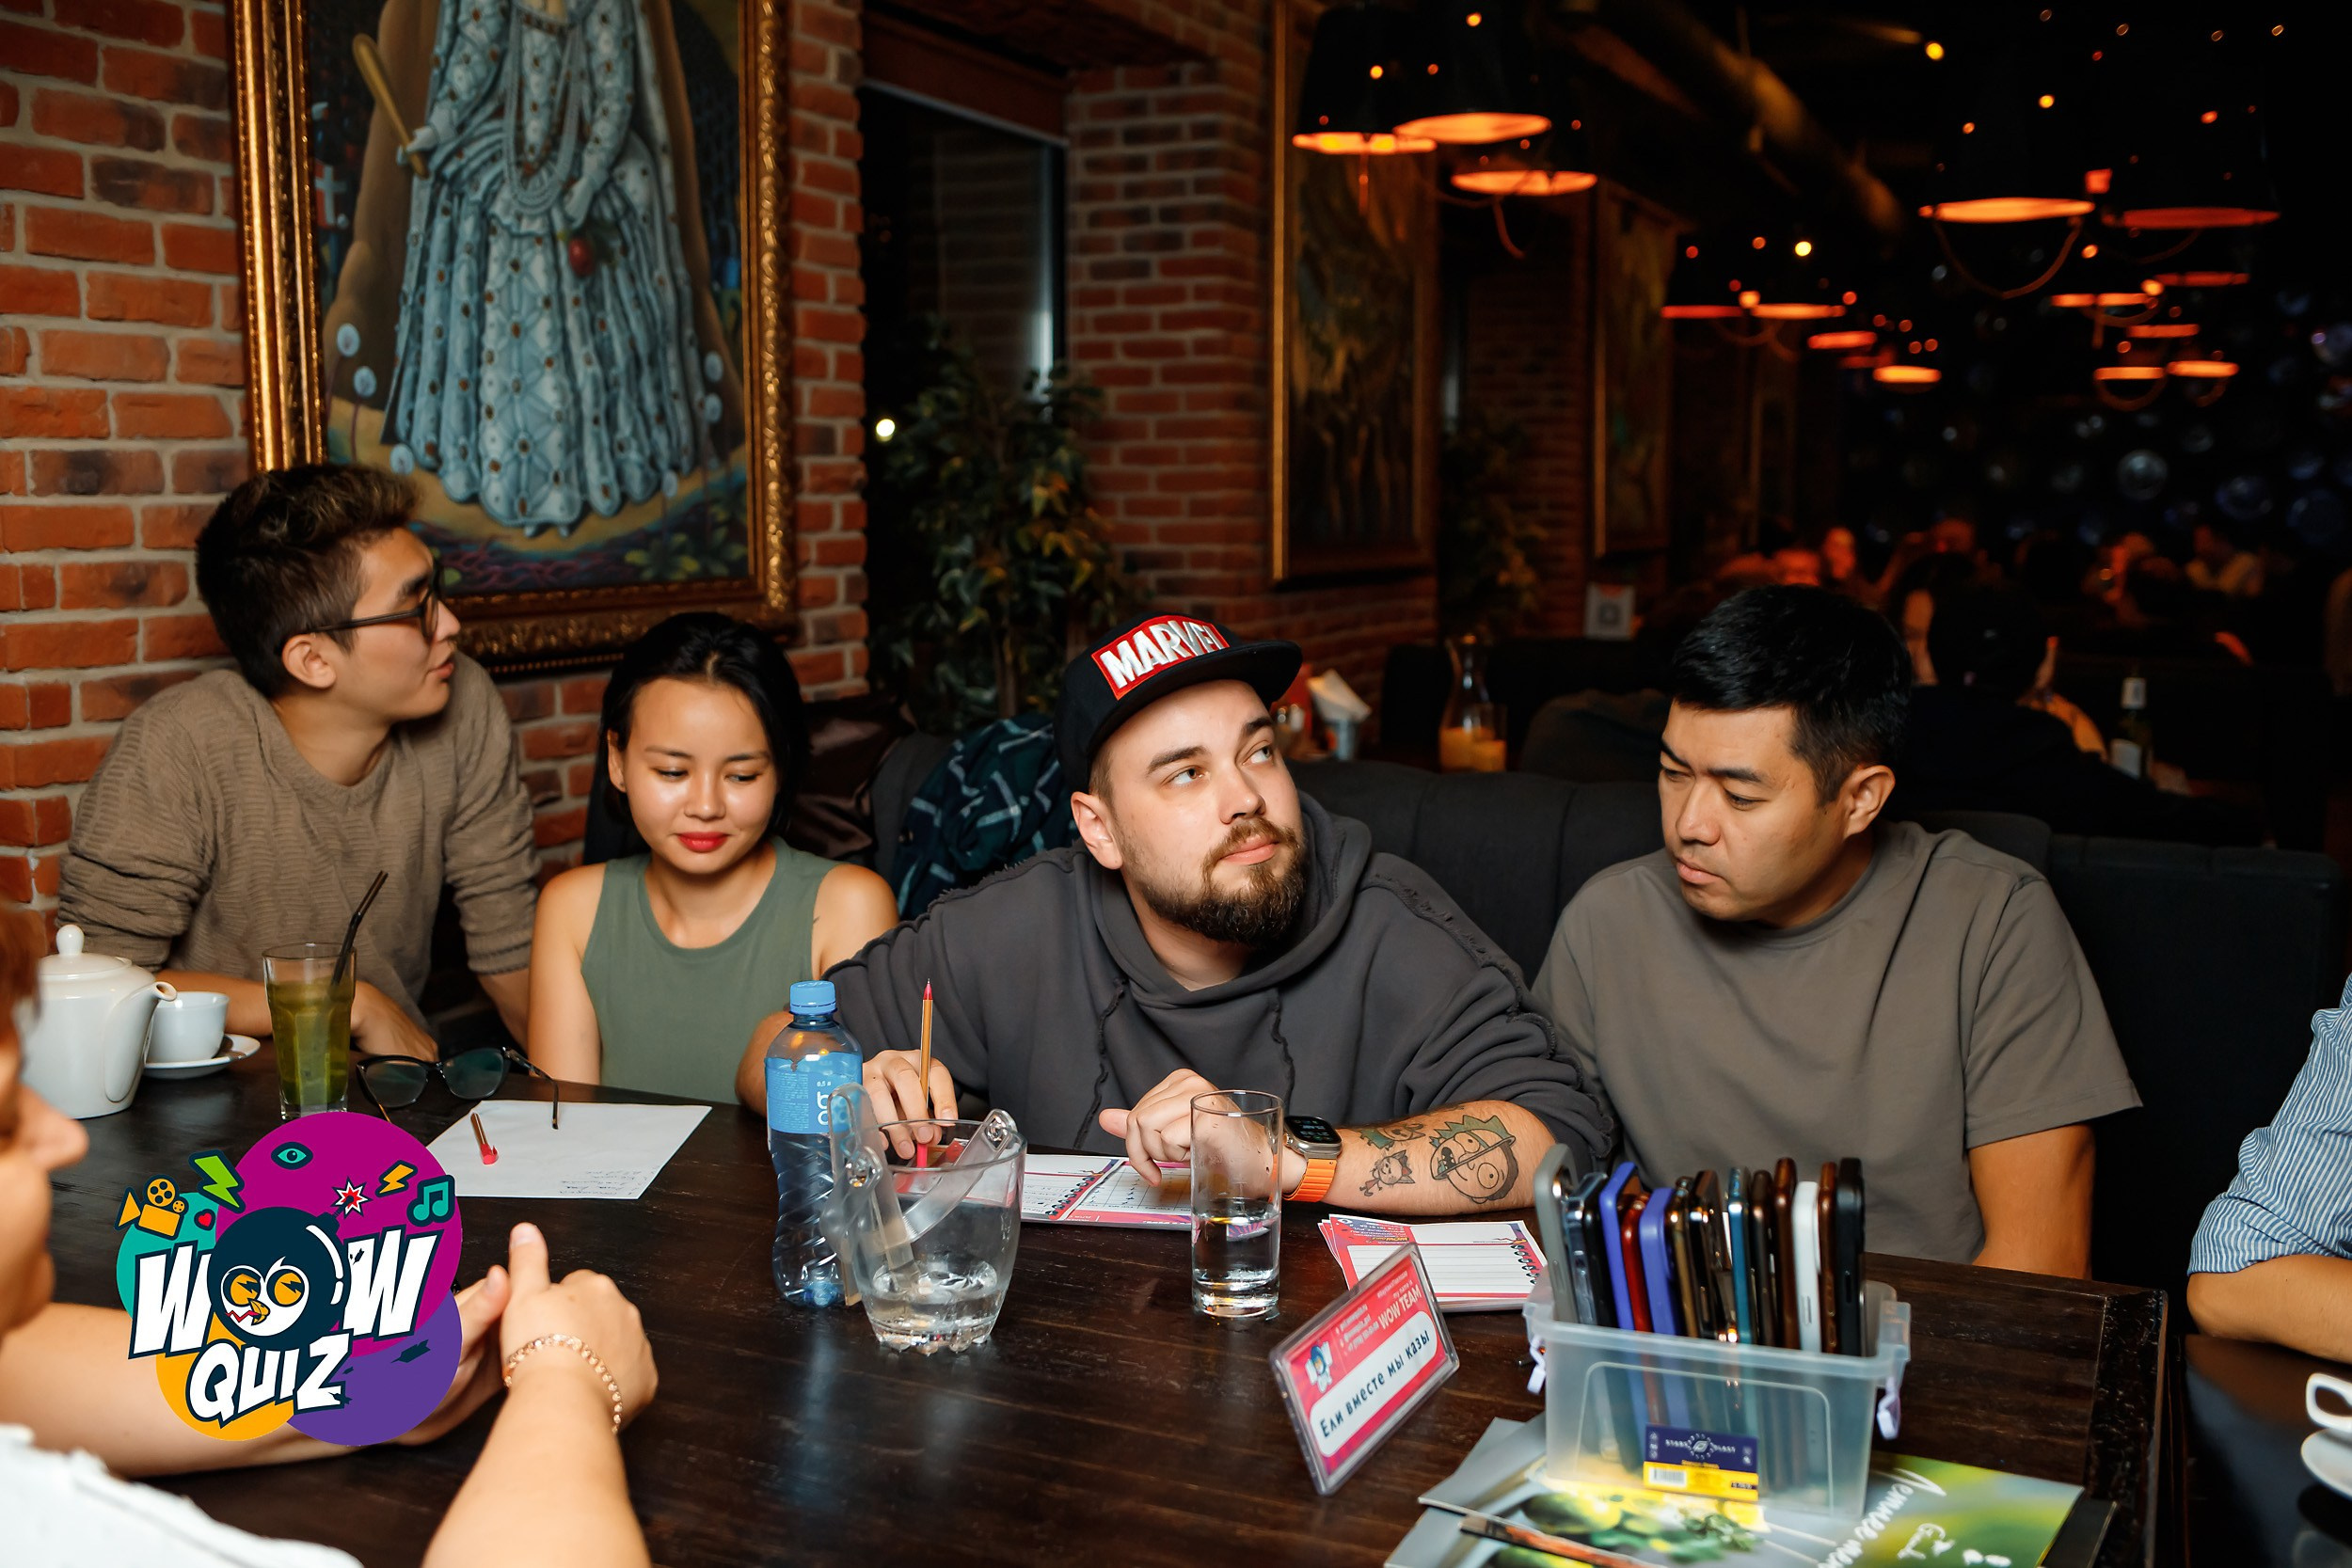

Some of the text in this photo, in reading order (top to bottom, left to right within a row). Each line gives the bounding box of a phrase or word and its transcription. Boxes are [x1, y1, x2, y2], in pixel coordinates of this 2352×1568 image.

[1377, 1301, 1401, 1330] WOW
[1398, 1284, 1422, 1312] TEAM
[1320, 1410, 1344, 1437] Ели
[1345, 1372, 1385, 1415] вместе
[1387, 1354, 1405, 1377] мы
[1405, 1330, 1430, 1359] казы
